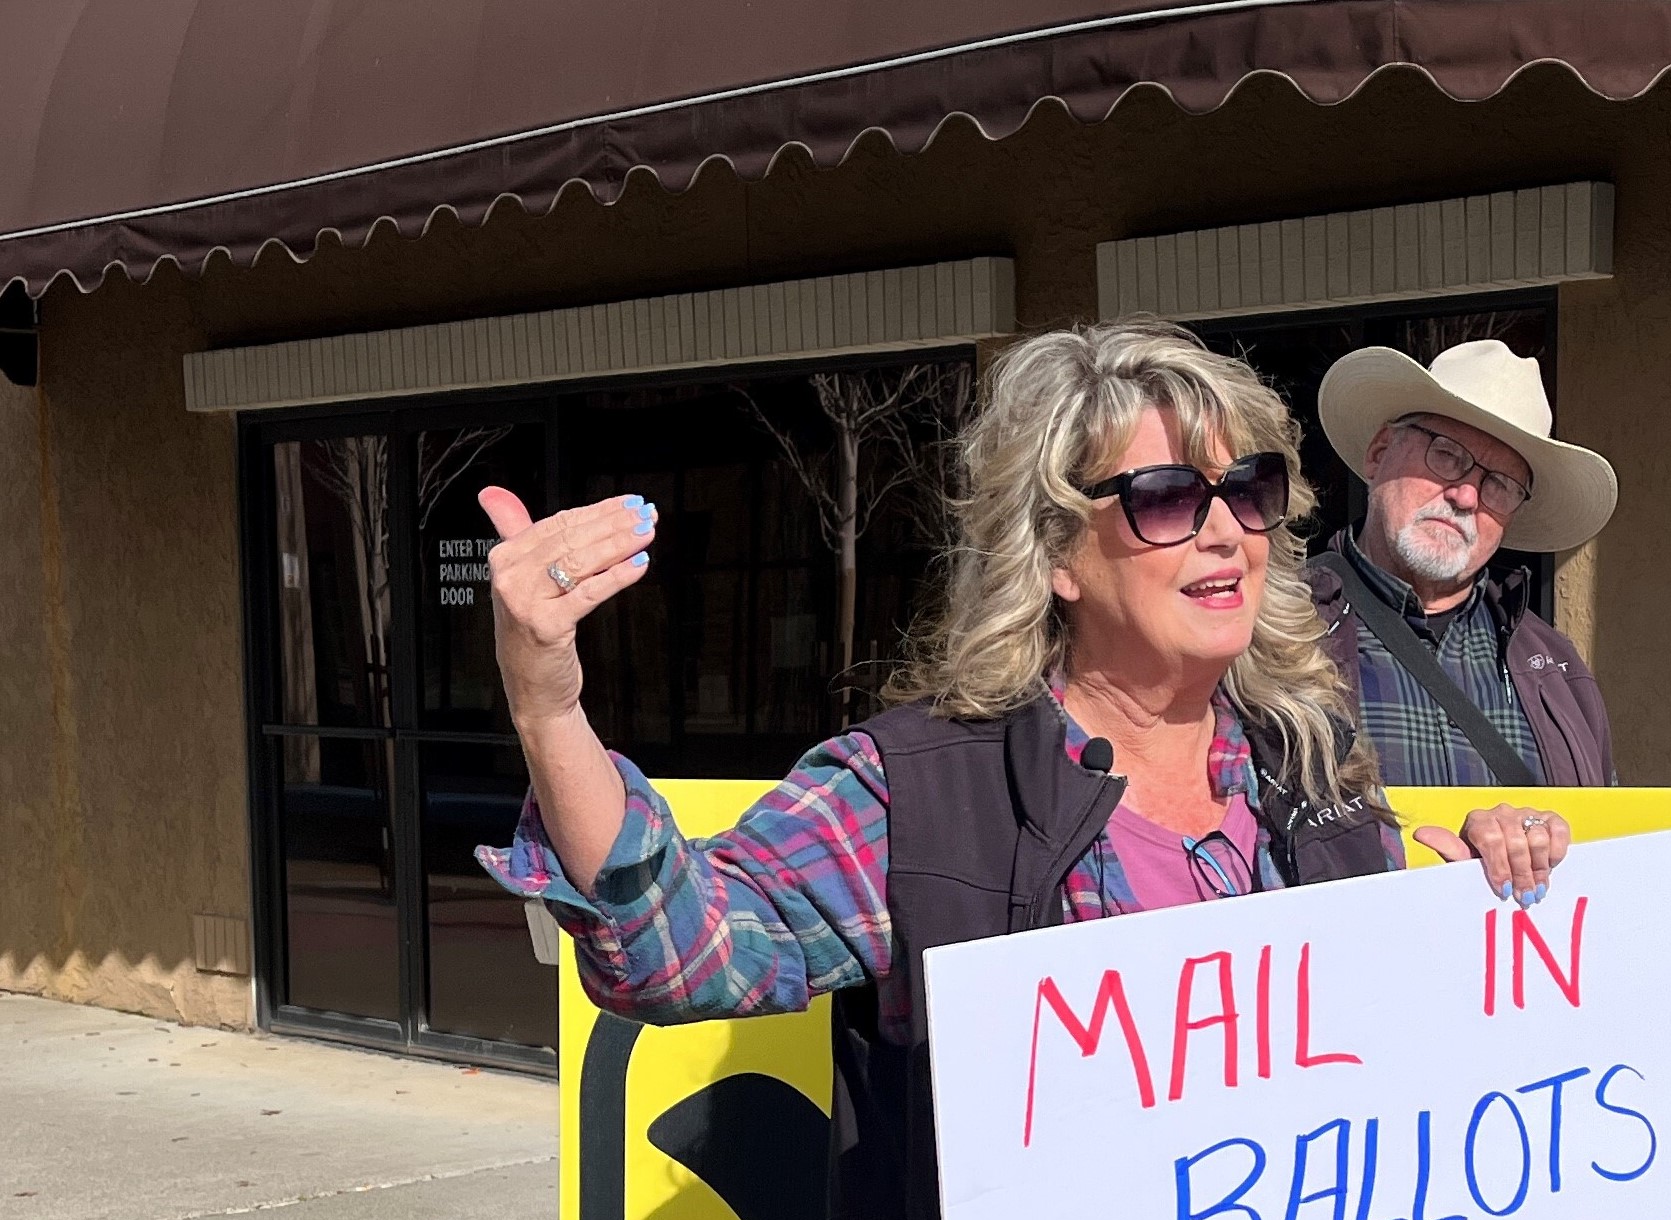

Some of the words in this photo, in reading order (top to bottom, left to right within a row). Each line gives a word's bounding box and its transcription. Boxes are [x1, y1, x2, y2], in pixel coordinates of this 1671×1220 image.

[439, 540, 473, 558] ENTER
[439, 563, 491, 582] PARKING
[440, 587, 474, 605] DOOR
[1024, 942, 1363, 1147] MAIL
[1485, 896, 1588, 1016] IN
